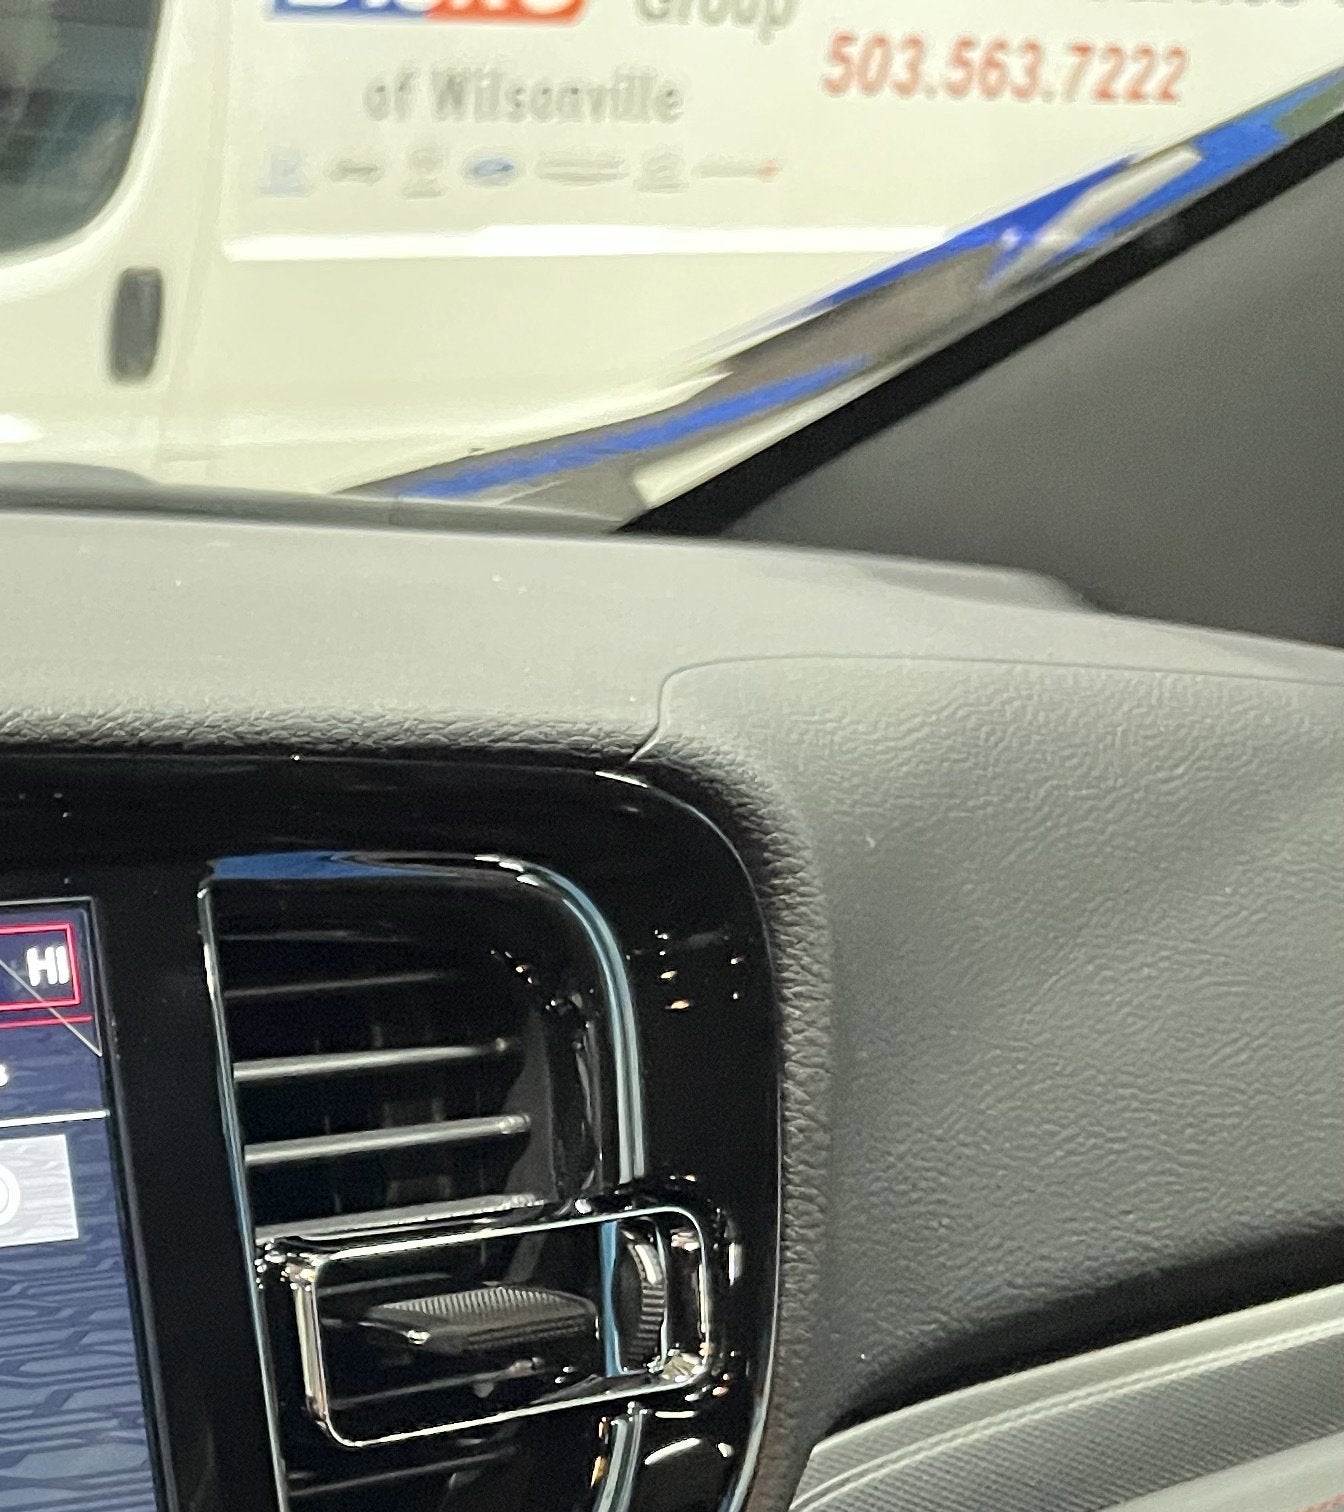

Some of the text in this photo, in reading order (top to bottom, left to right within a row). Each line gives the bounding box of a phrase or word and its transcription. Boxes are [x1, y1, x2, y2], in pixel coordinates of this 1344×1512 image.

[431, 66, 685, 122] Wilsonville
[822, 31, 1188, 103] 503.563.7222
[25, 945, 71, 987] HI
